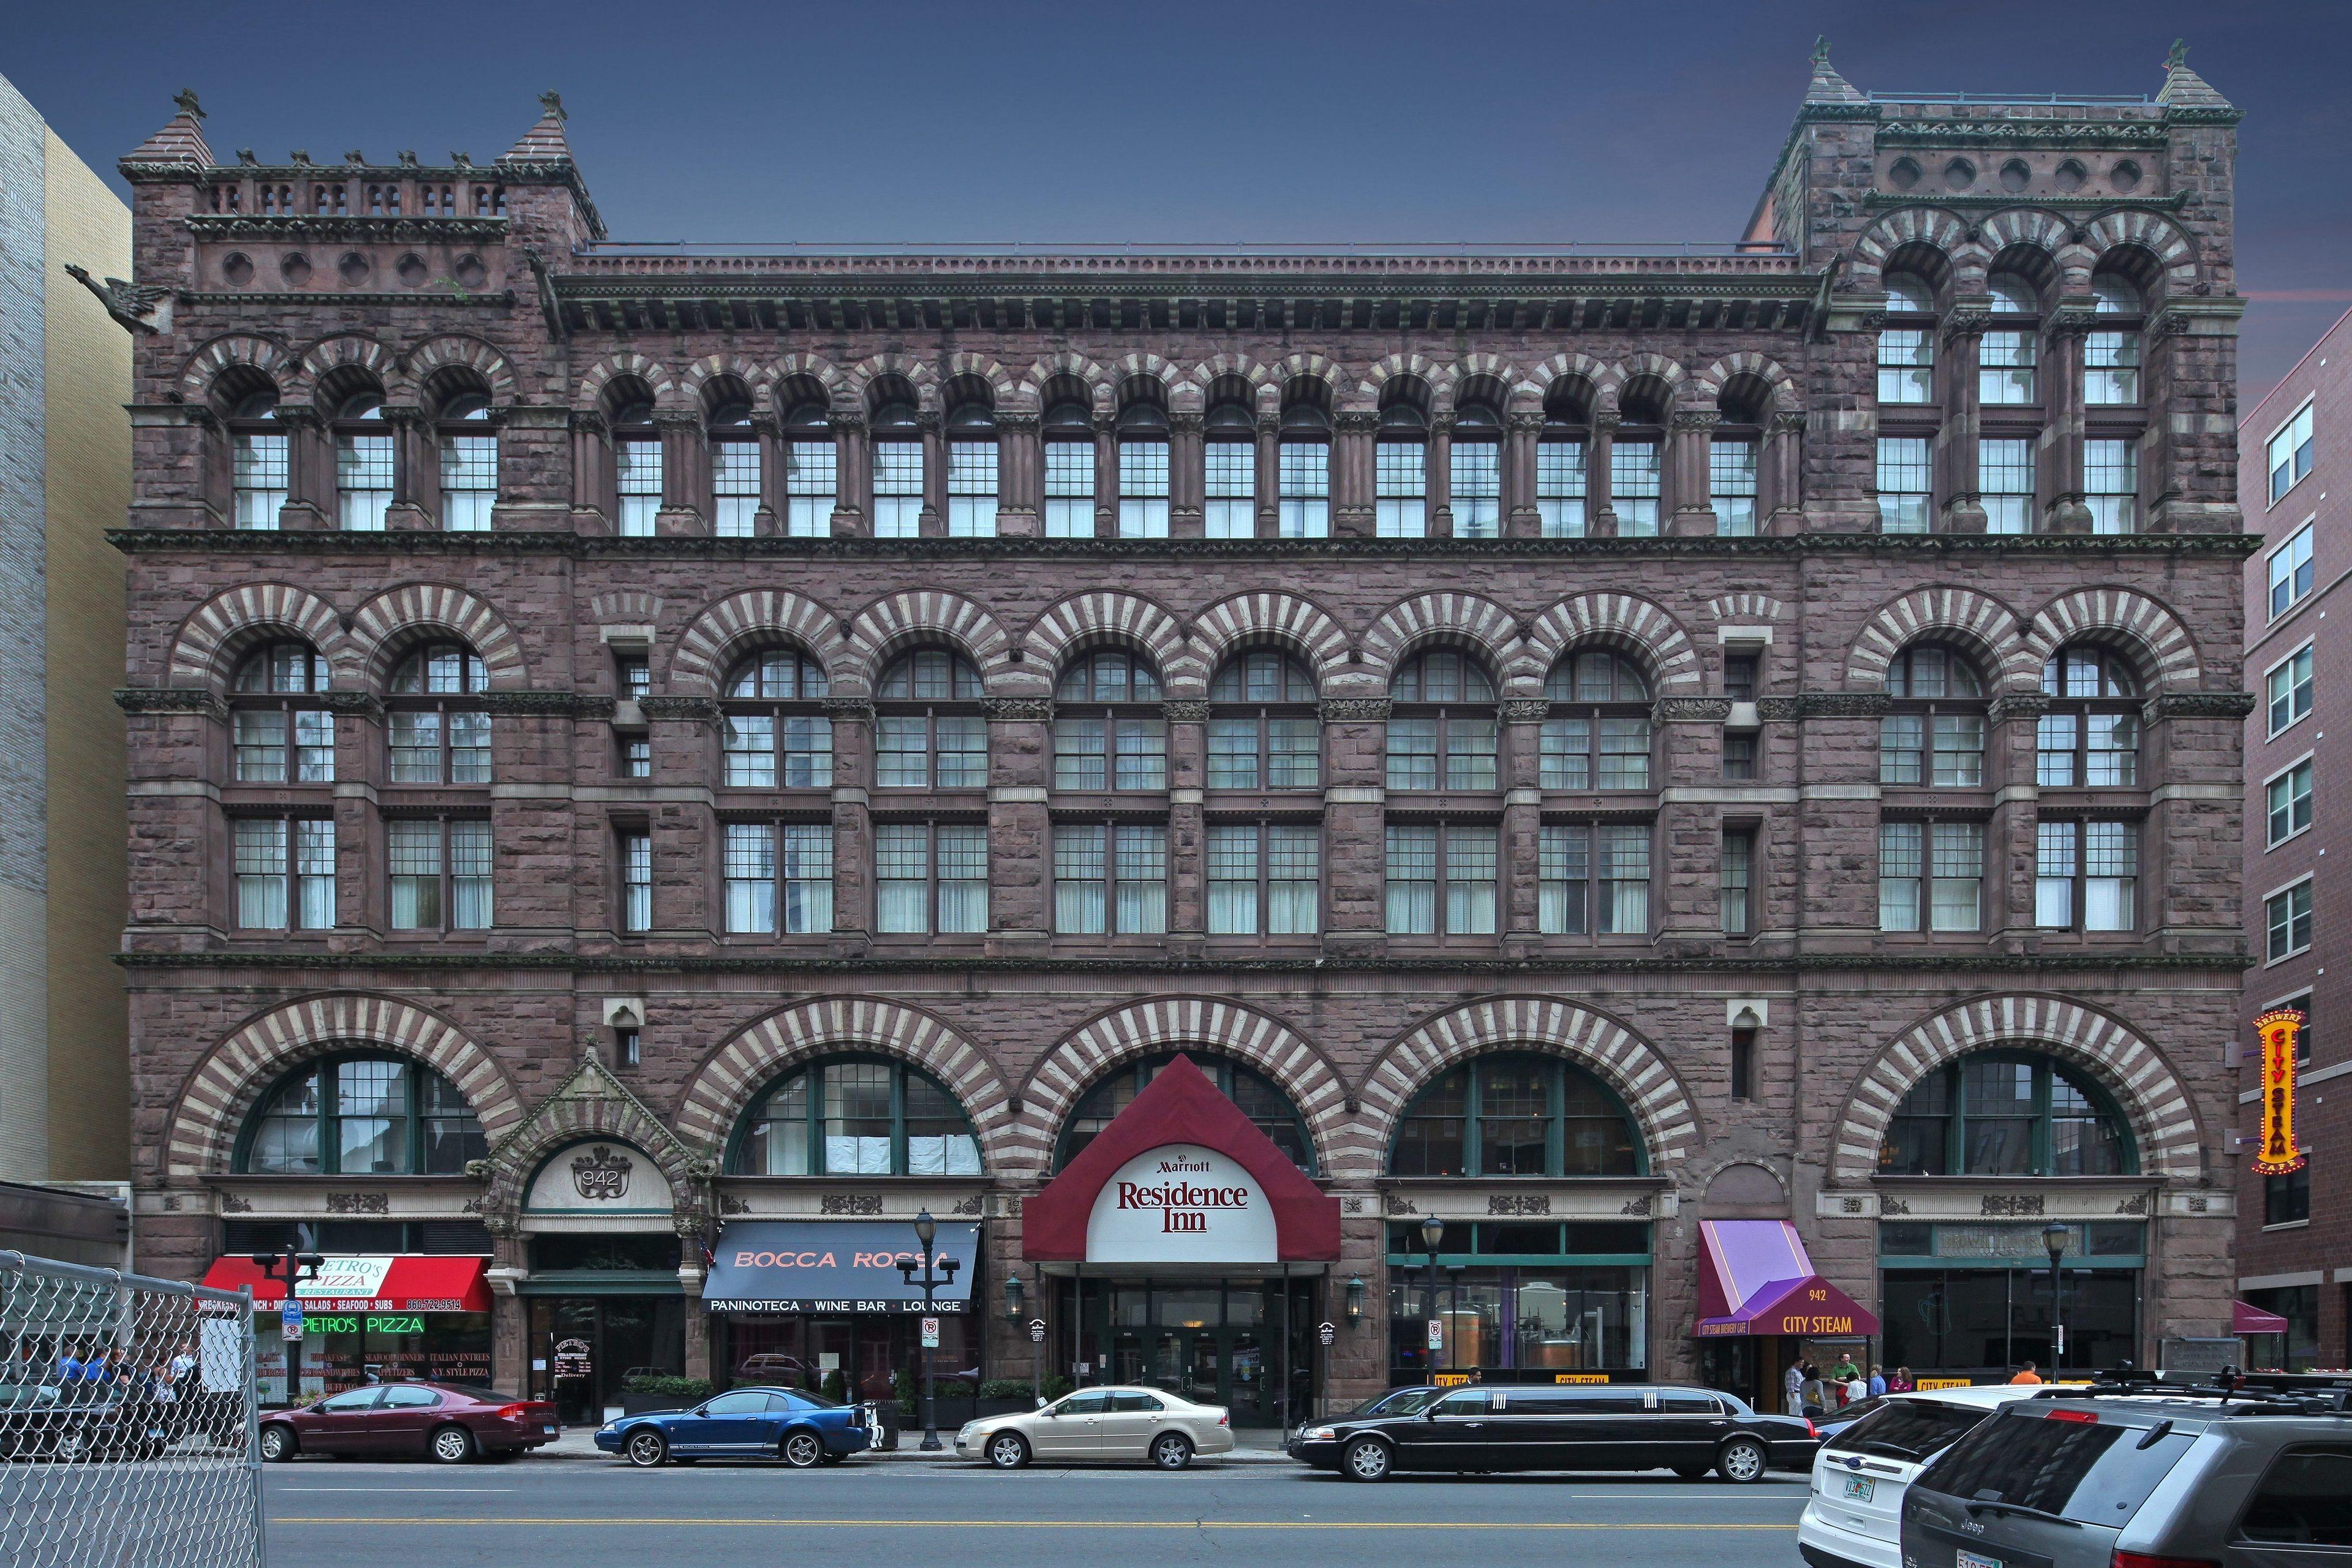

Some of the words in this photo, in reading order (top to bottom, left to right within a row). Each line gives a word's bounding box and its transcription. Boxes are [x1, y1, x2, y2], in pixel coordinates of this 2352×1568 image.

[2255, 1014, 2301, 1028] BREWERY
[2271, 1028, 2285, 1083] CITY
[2269, 1087, 2286, 1155] STEAM
[1156, 1161, 1210, 1174] Marriott
[2259, 1159, 2296, 1170] CAFE
[582, 1171, 618, 1185] 942
[1117, 1181, 1248, 1209] Residence
[1161, 1207, 1207, 1232] Inn
[734, 1251, 837, 1268] BOCCA
[307, 1275, 366, 1286] PIZZA
[1809, 1289, 1826, 1301] 942
[304, 1300, 331, 1310] SALADS
[337, 1300, 368, 1310] SEAFOOD
[374, 1300, 393, 1310] SUBS
[407, 1299, 462, 1310] 860-722-9514
[710, 1300, 801, 1311] PANINOTECA
[814, 1300, 850, 1311] WINE
[857, 1301, 886, 1311] BAR
[302, 1317, 357, 1332] PIETRO'S
[367, 1317, 424, 1332] PIZZA
[1709, 1324, 1721, 1335] STEAM
[1721, 1323, 1736, 1334] BREWERY
[1783, 1316, 1809, 1333] CITY
[1812, 1316, 1852, 1333] STEAM
[398, 1353, 425, 1362] DINNERS
[430, 1353, 458, 1362] ITALIAN
[459, 1353, 490, 1362] ENTREES
[318, 1368, 360, 1377] SANDWICHES
[1435, 1377, 1448, 1386] ITY
[1921, 1382, 1938, 1391] CITY
[1961, 1518, 1985, 1536] Jeep
